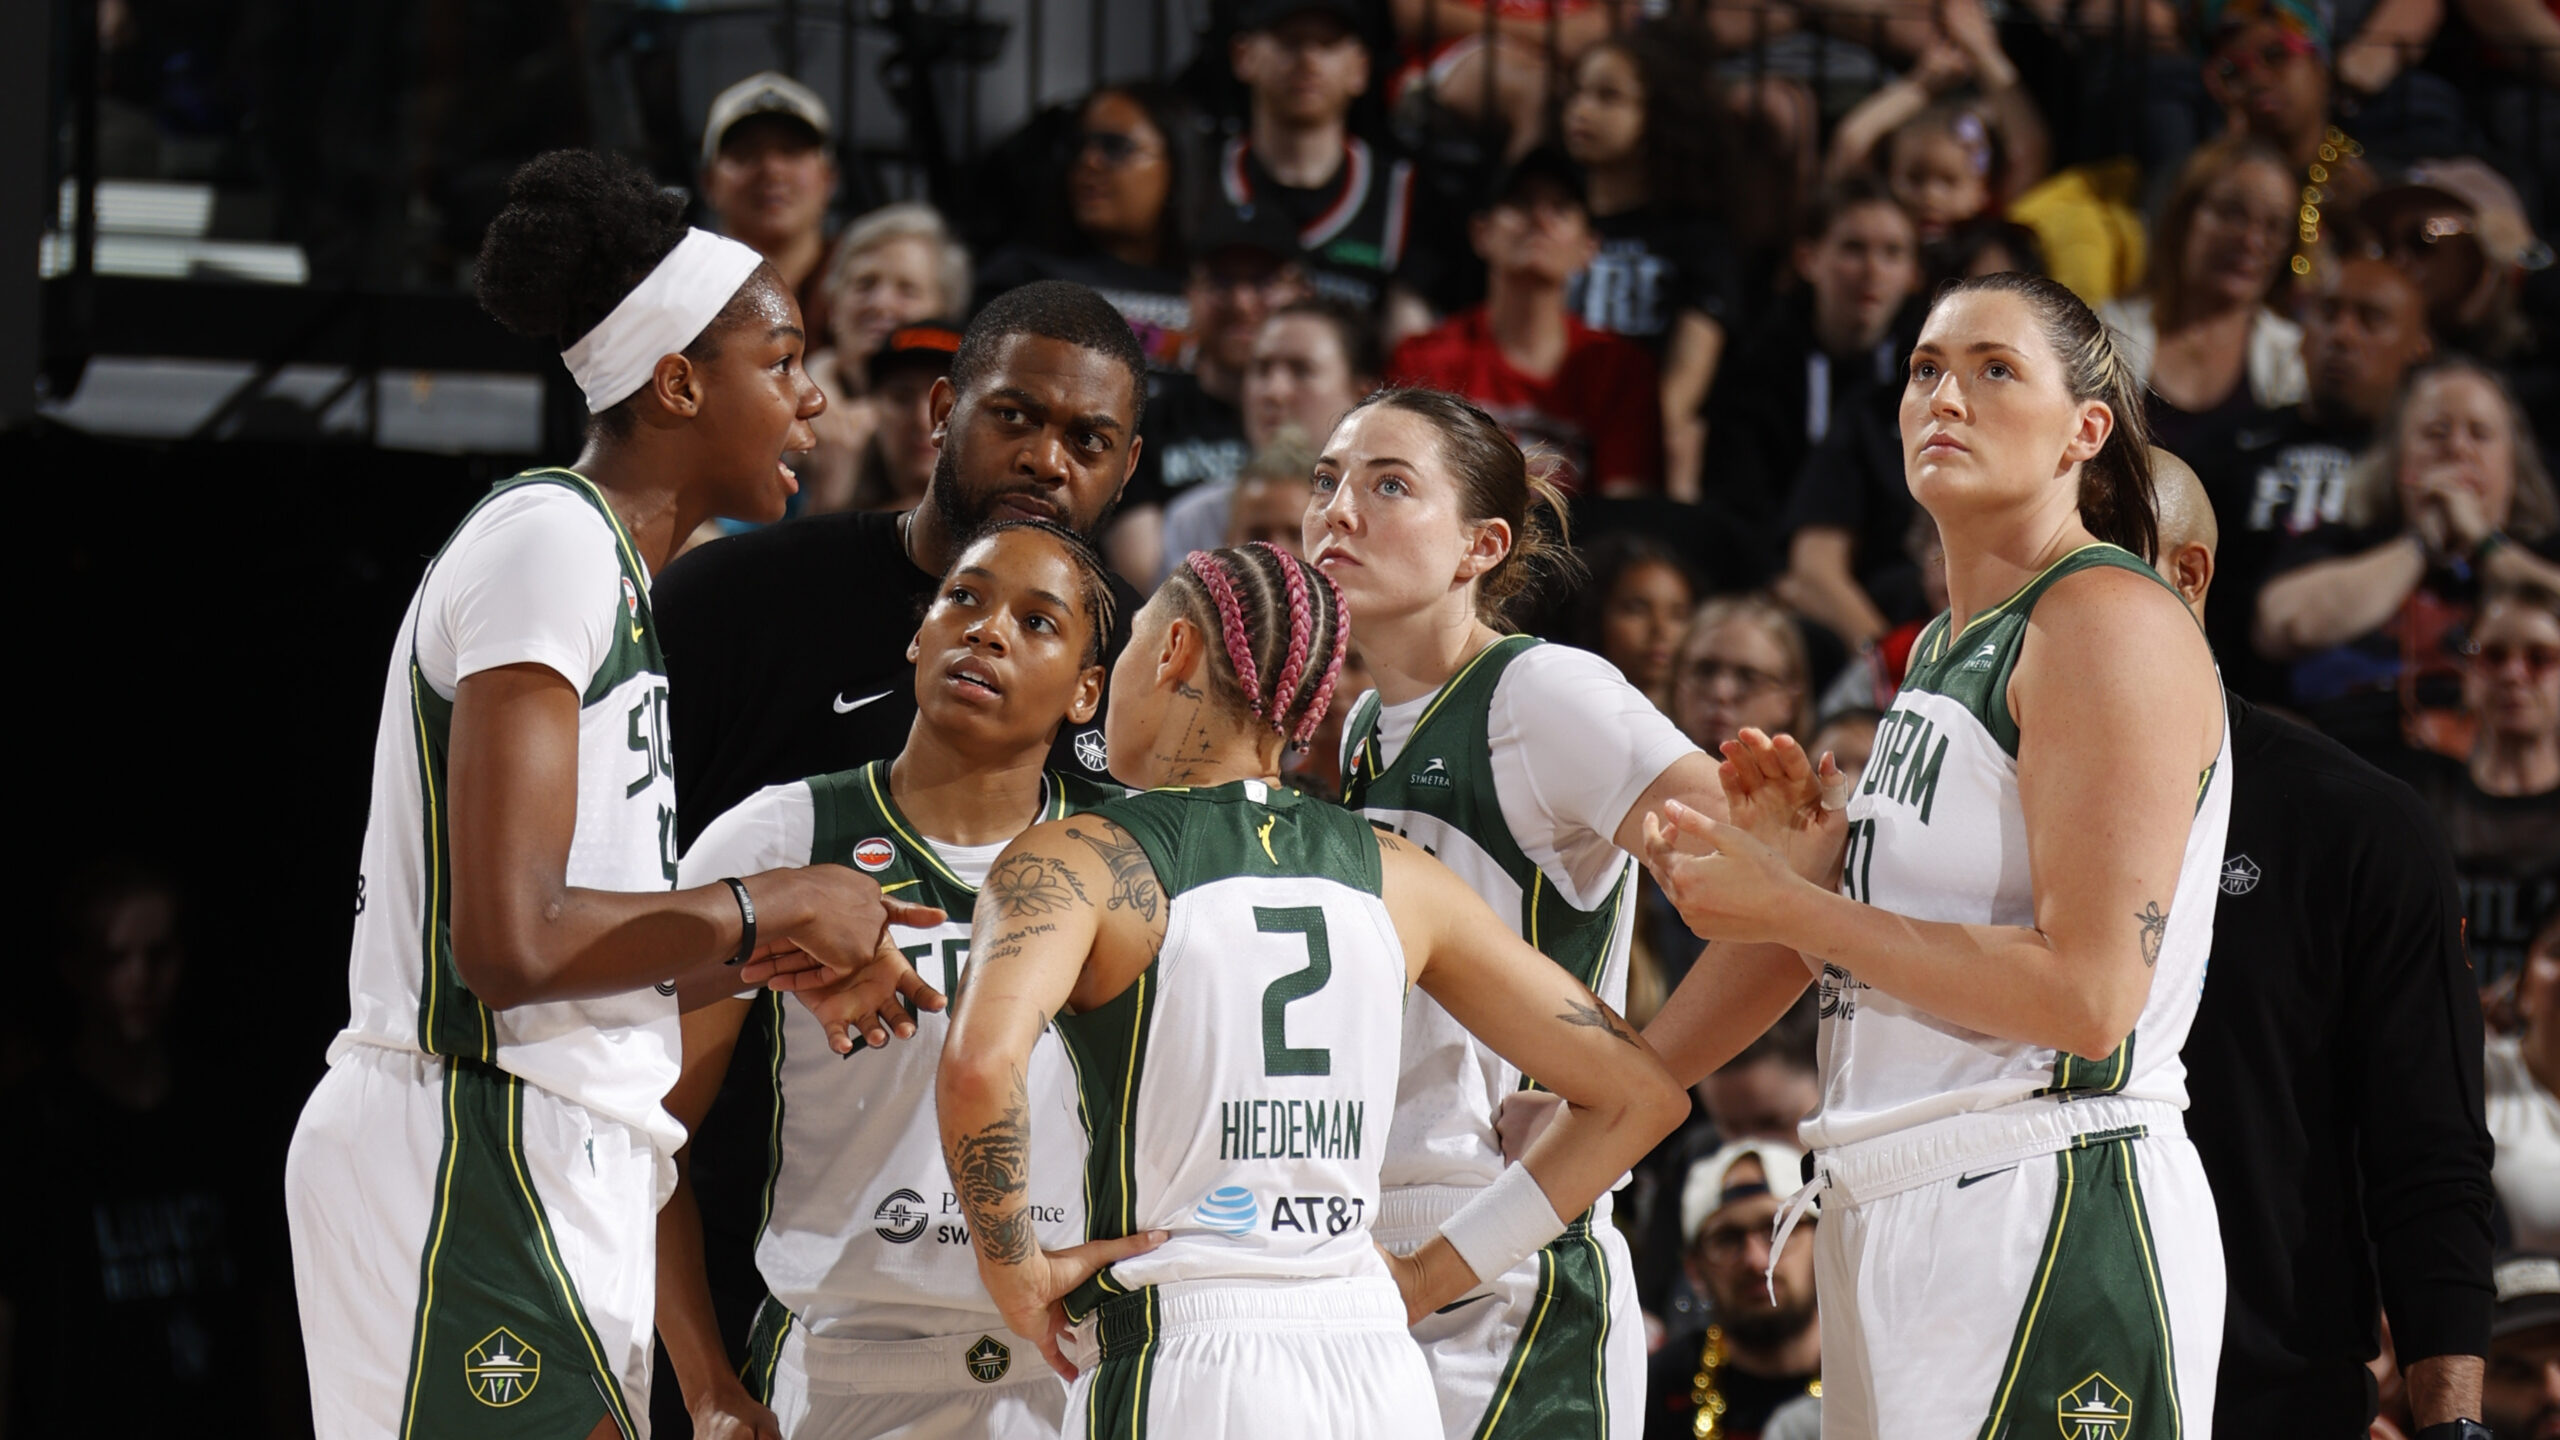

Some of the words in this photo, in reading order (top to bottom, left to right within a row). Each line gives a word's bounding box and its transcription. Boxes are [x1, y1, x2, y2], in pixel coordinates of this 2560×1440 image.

[1410, 774, 1450, 787] SYMETRA
[1025, 923, 1057, 937] You
[1253, 907, 1332, 1077] 2
[1220, 1100, 1364, 1161] HIEDEMAN
